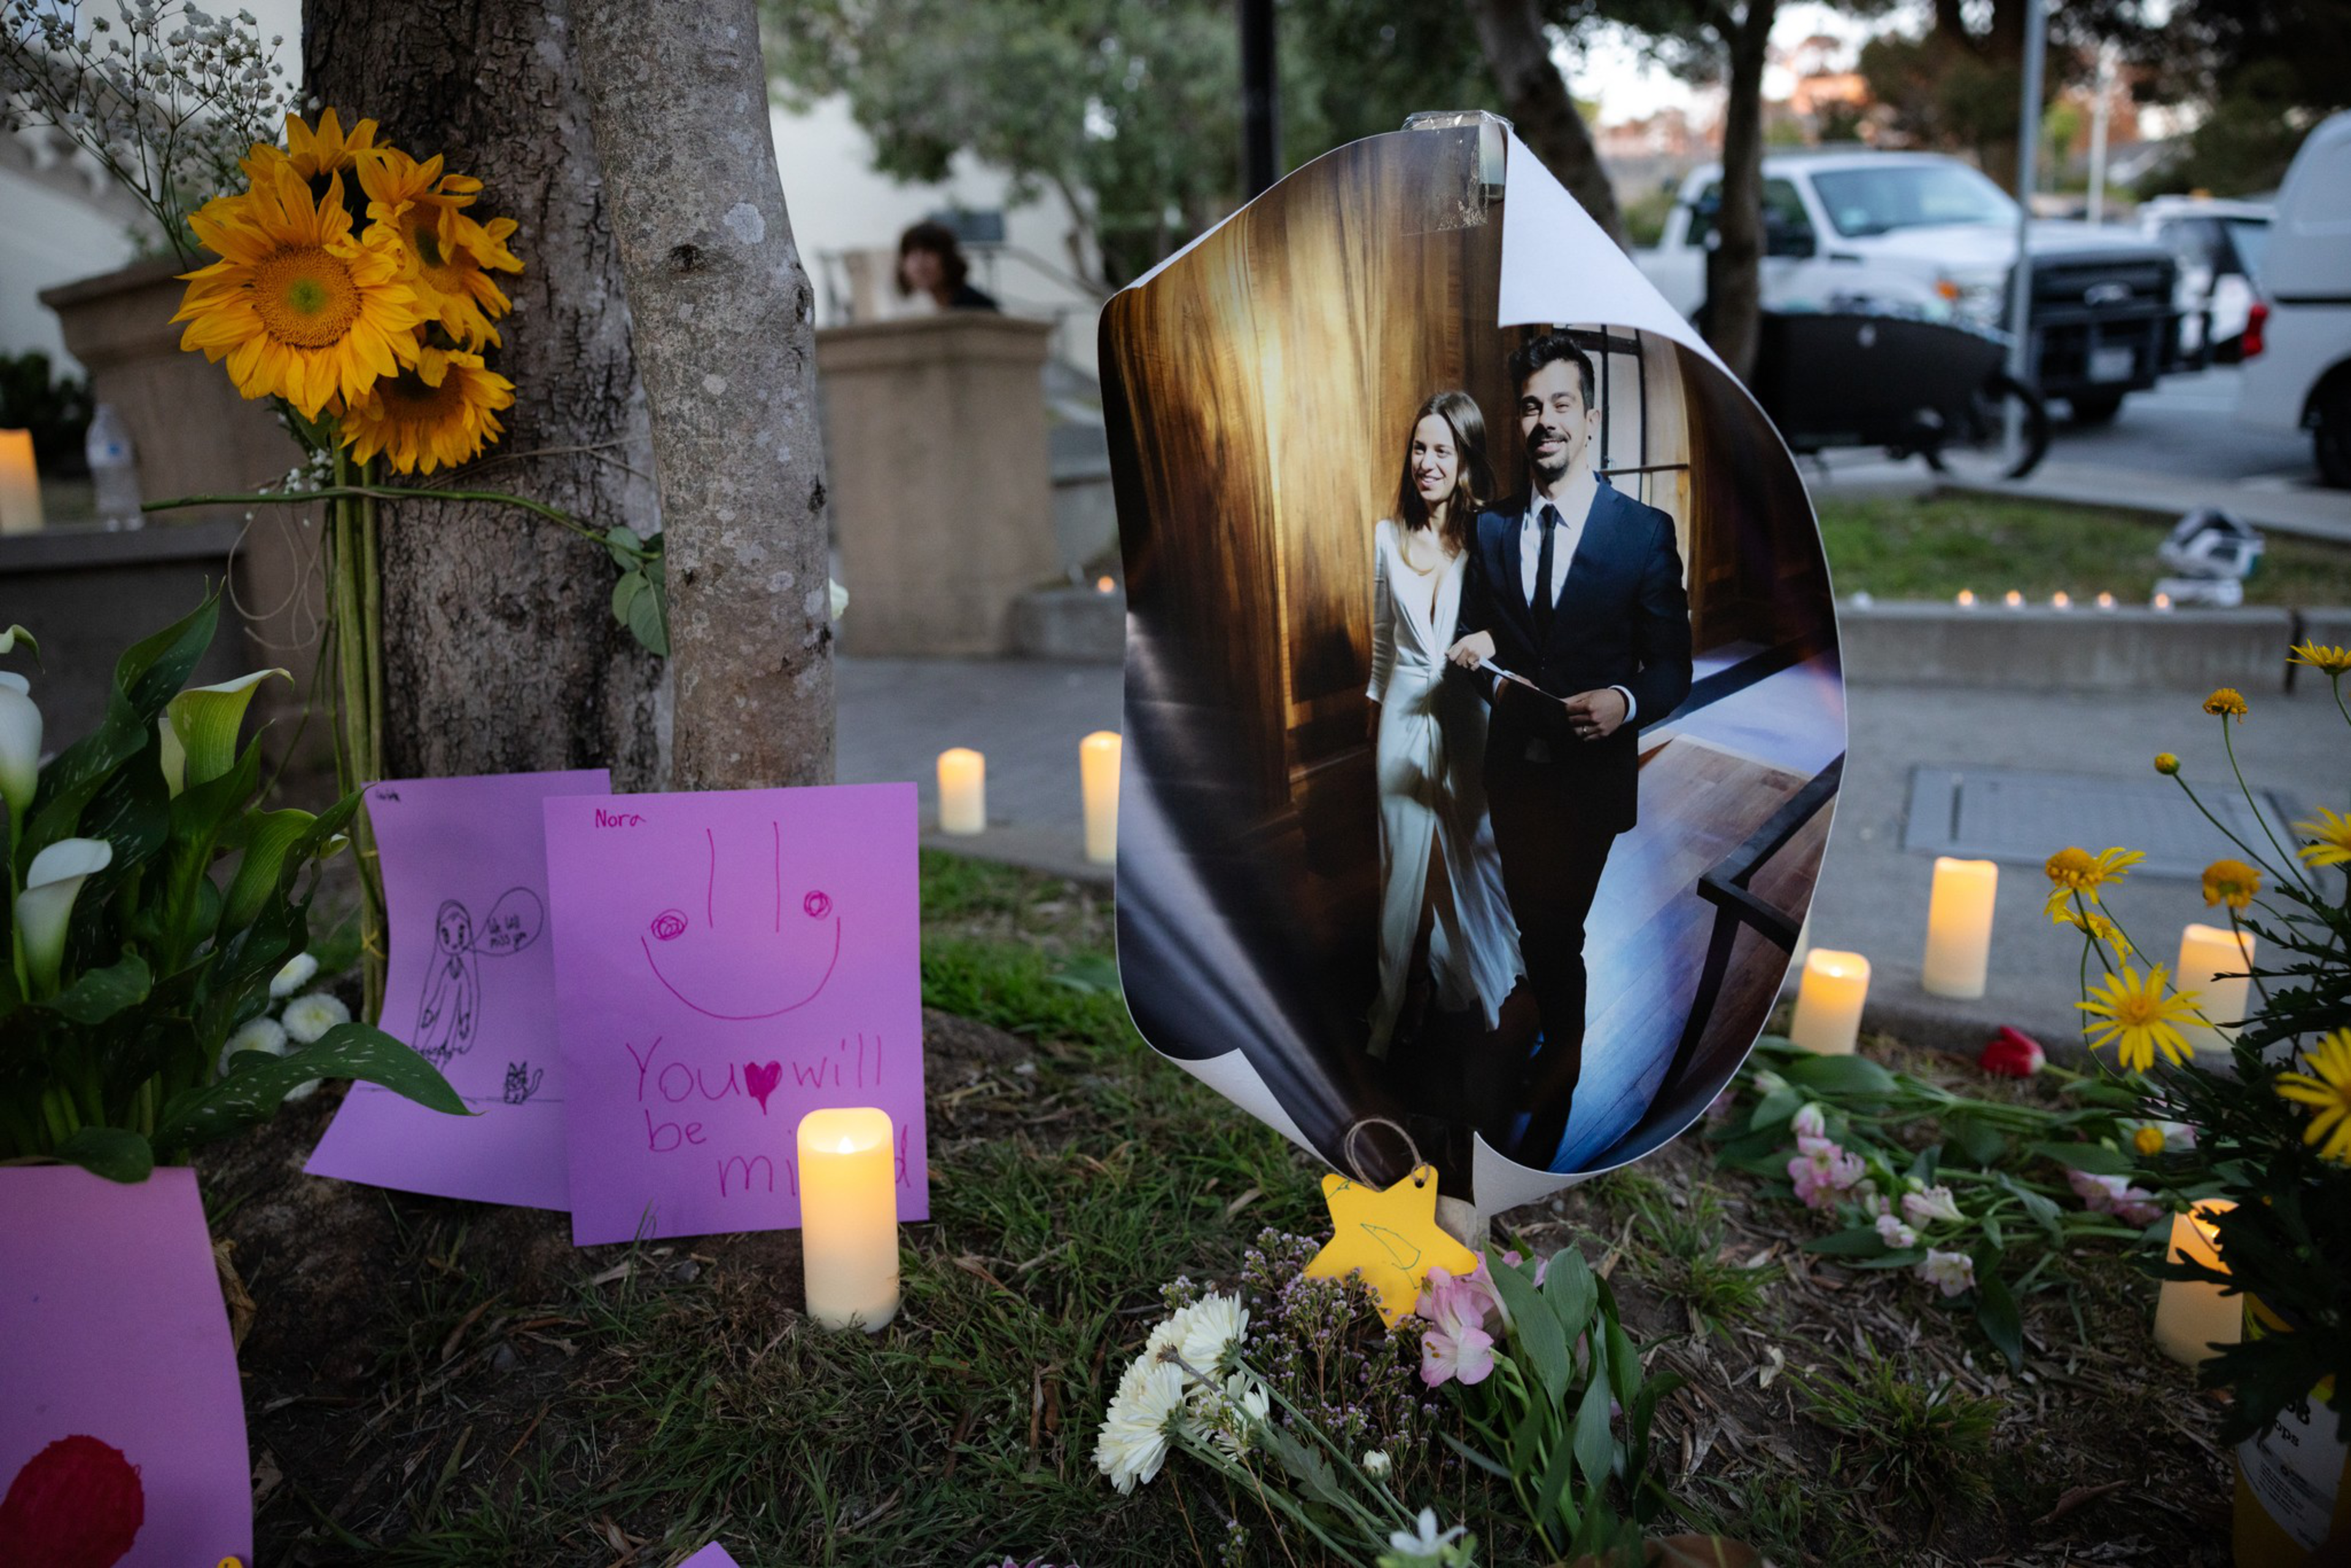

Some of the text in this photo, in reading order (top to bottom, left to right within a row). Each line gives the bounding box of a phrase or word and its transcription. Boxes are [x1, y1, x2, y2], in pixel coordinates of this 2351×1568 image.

[596, 808, 647, 828] Nora
[626, 1032, 882, 1101] You will
[645, 1108, 707, 1152] be
[718, 1123, 911, 1198] mid
